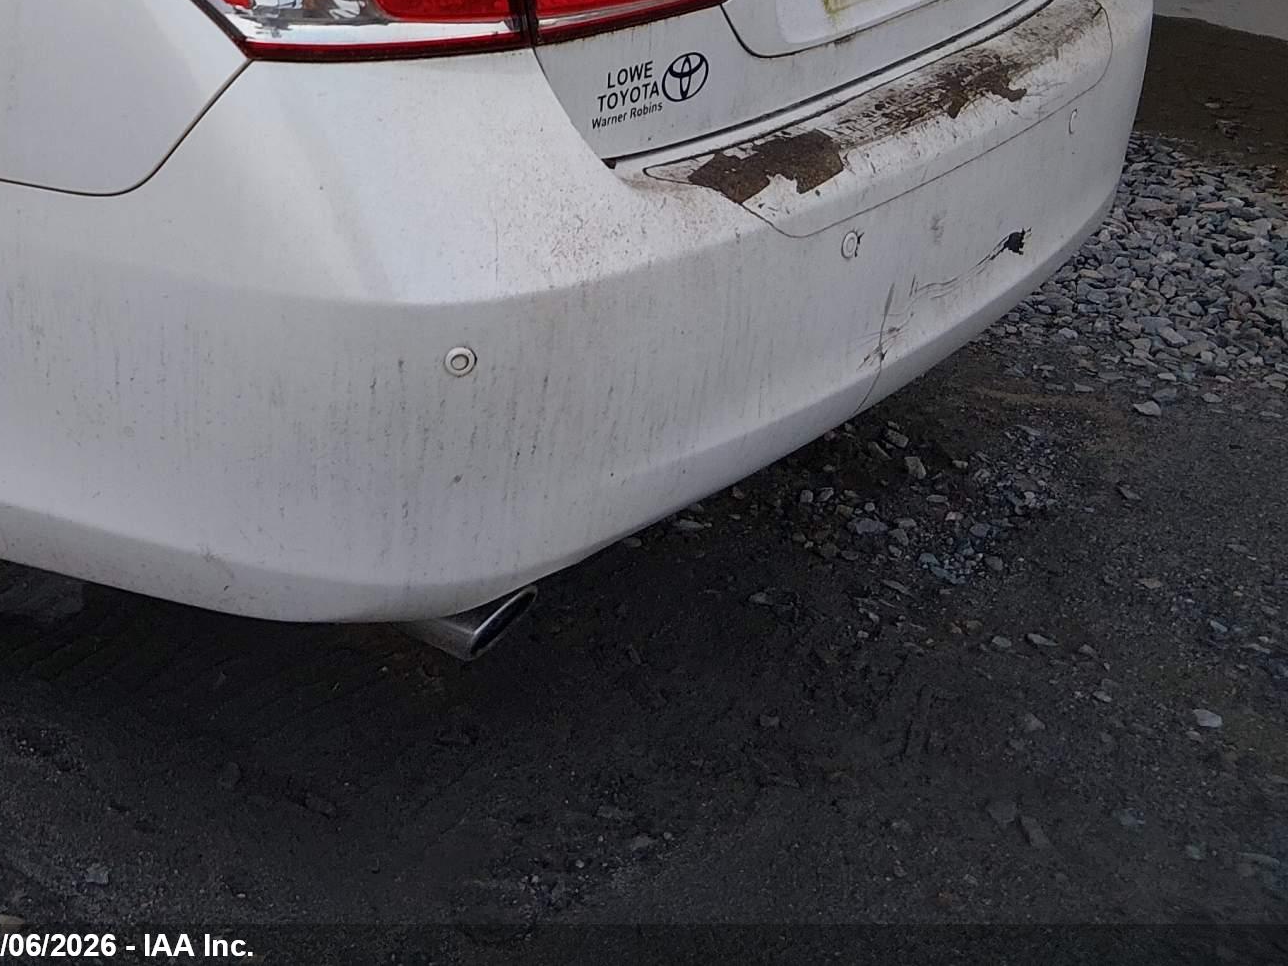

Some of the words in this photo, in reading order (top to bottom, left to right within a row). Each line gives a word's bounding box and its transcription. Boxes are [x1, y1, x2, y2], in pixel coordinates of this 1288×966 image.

[607, 60, 654, 89] LOWE
[597, 81, 660, 113] TOYOTA
[591, 111, 628, 130] Warner
[630, 102, 663, 120] Robins
